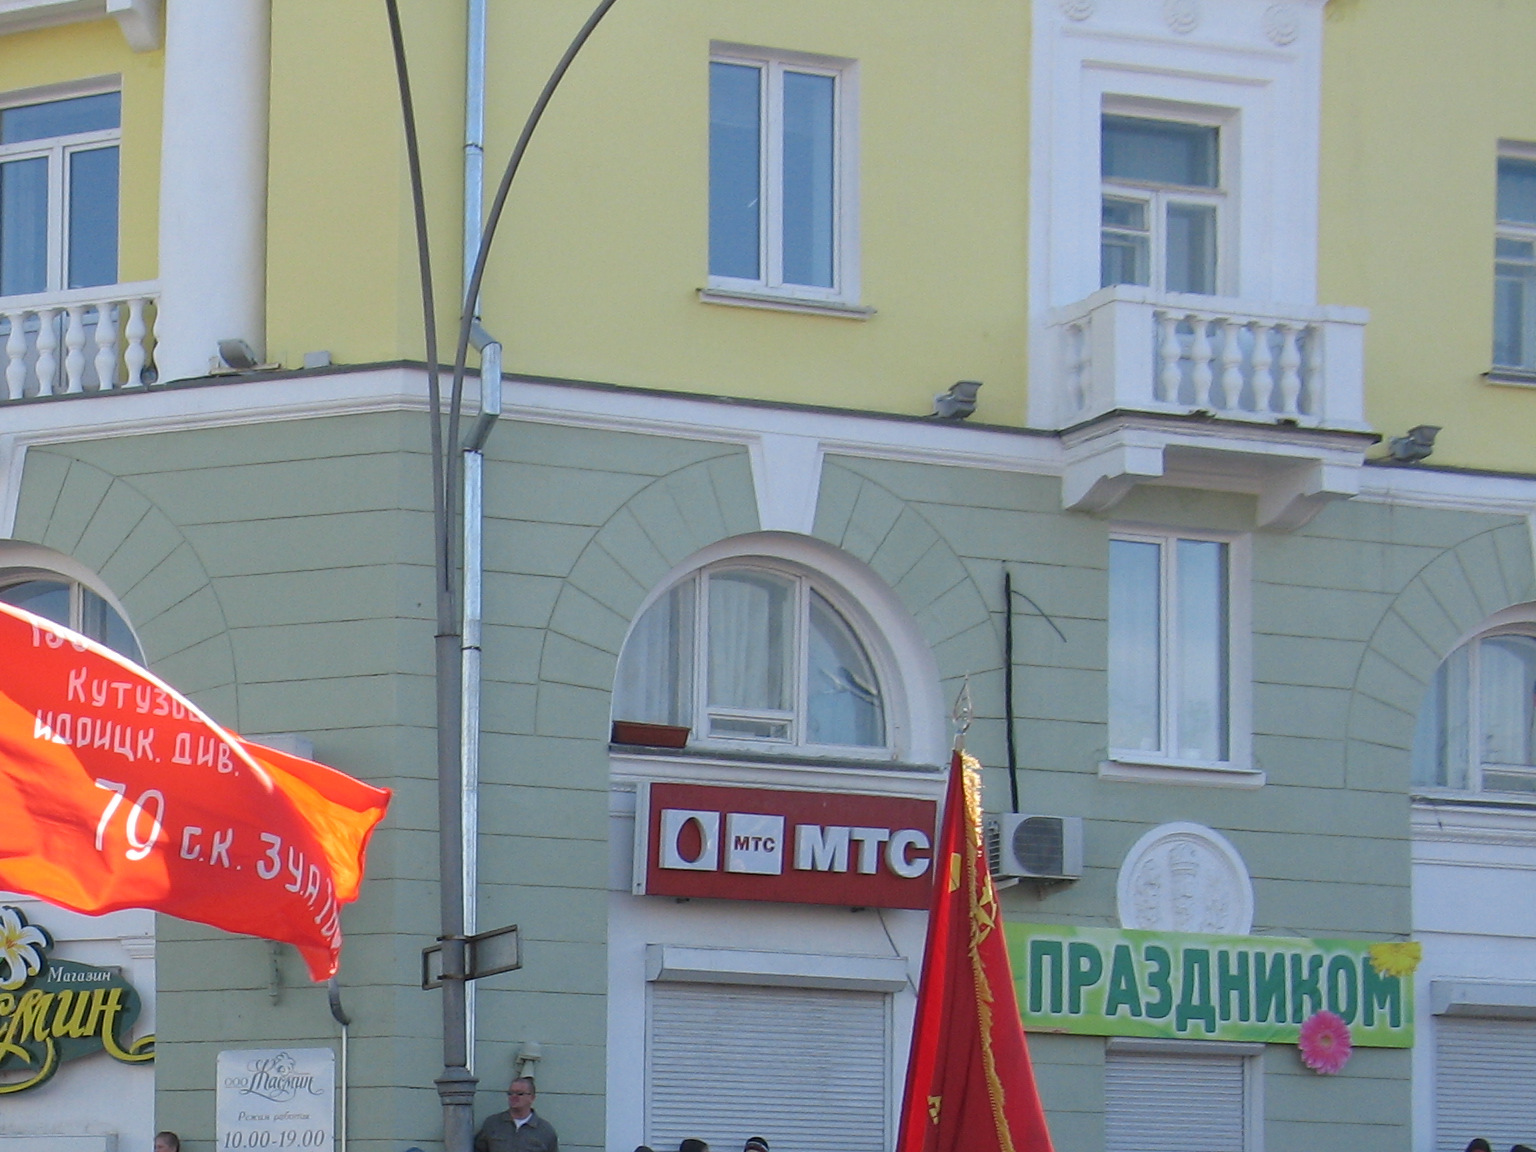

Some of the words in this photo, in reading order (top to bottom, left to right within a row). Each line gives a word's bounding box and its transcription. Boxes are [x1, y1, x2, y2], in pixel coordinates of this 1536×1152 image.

[734, 835, 776, 853] МТС
[794, 823, 931, 879] МТС
[47, 966, 112, 983] Магазин
[1028, 939, 1402, 1034] ПРАЗДНИКОМ
[224, 1129, 325, 1149] 10.00-19.00
